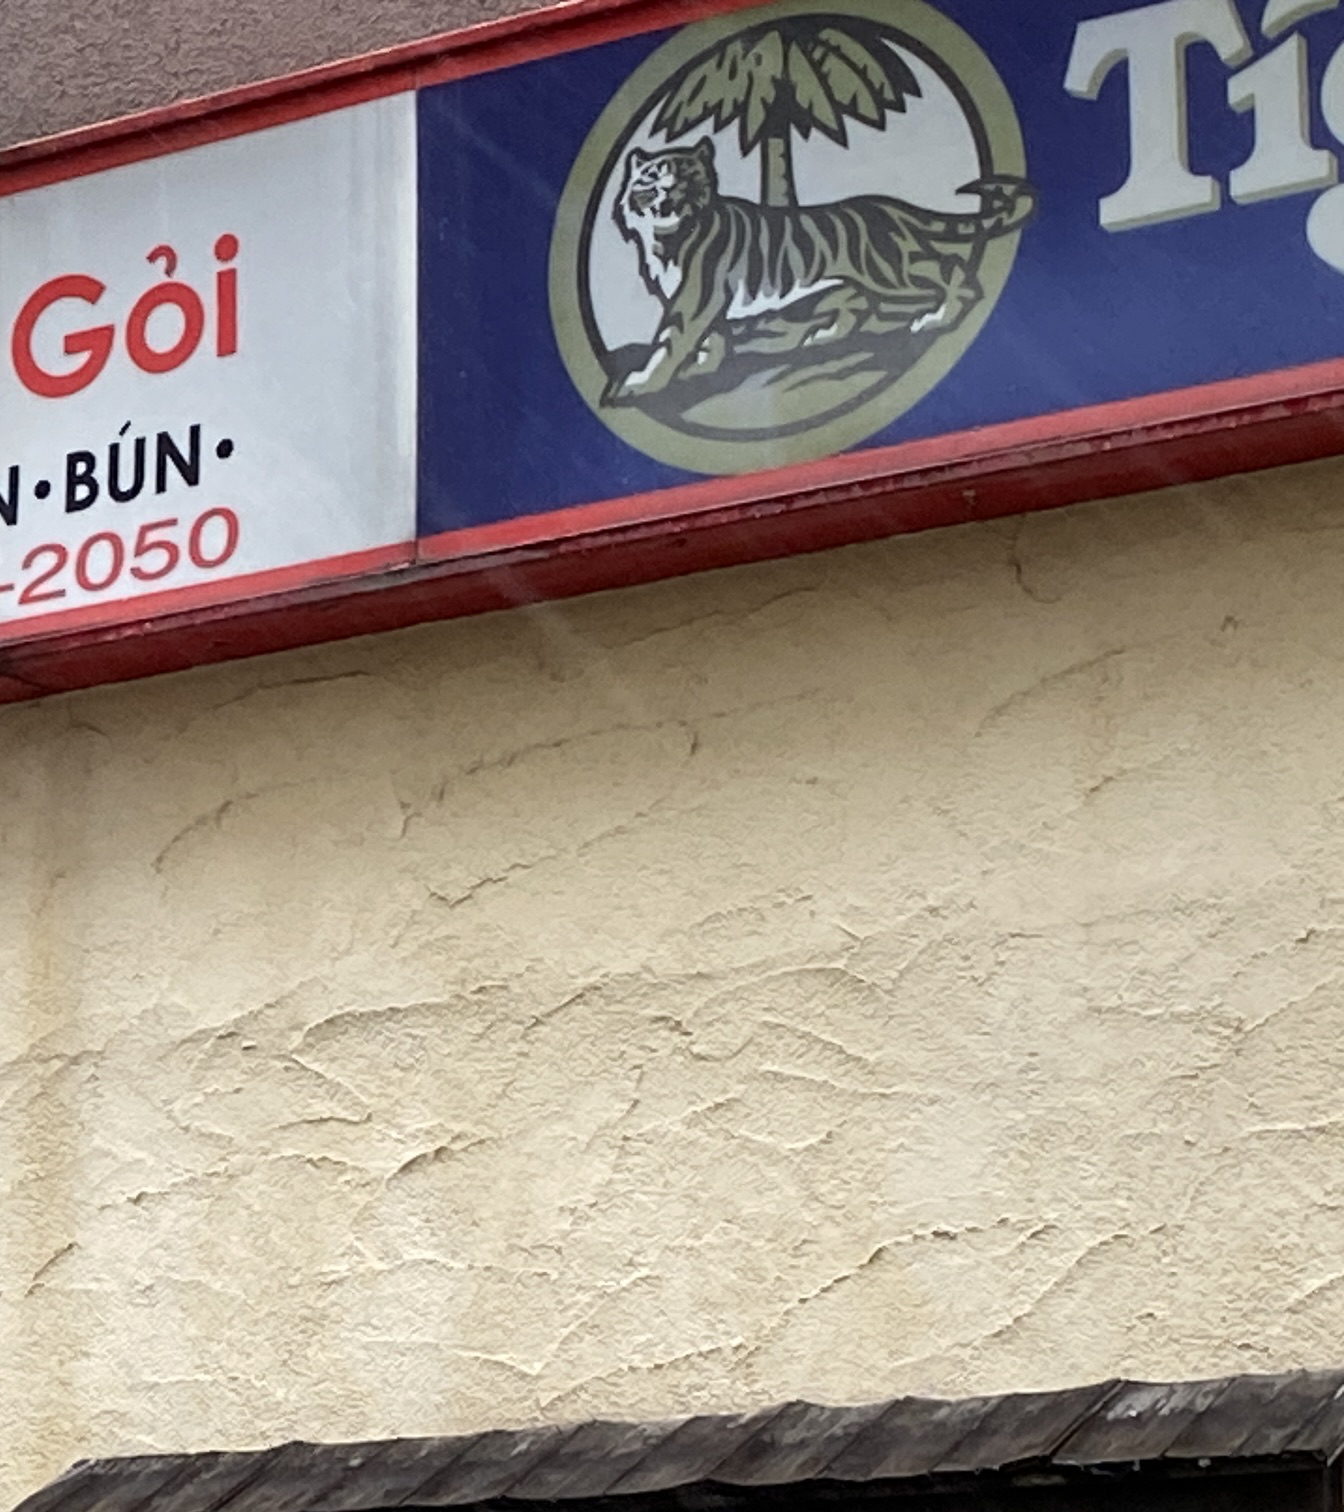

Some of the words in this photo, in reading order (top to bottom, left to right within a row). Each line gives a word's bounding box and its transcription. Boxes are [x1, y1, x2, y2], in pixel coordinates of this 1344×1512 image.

[1062, 0, 1344, 276] Ti
[9, 232, 239, 399] Gỏi
[64, 420, 202, 515] BÚN
